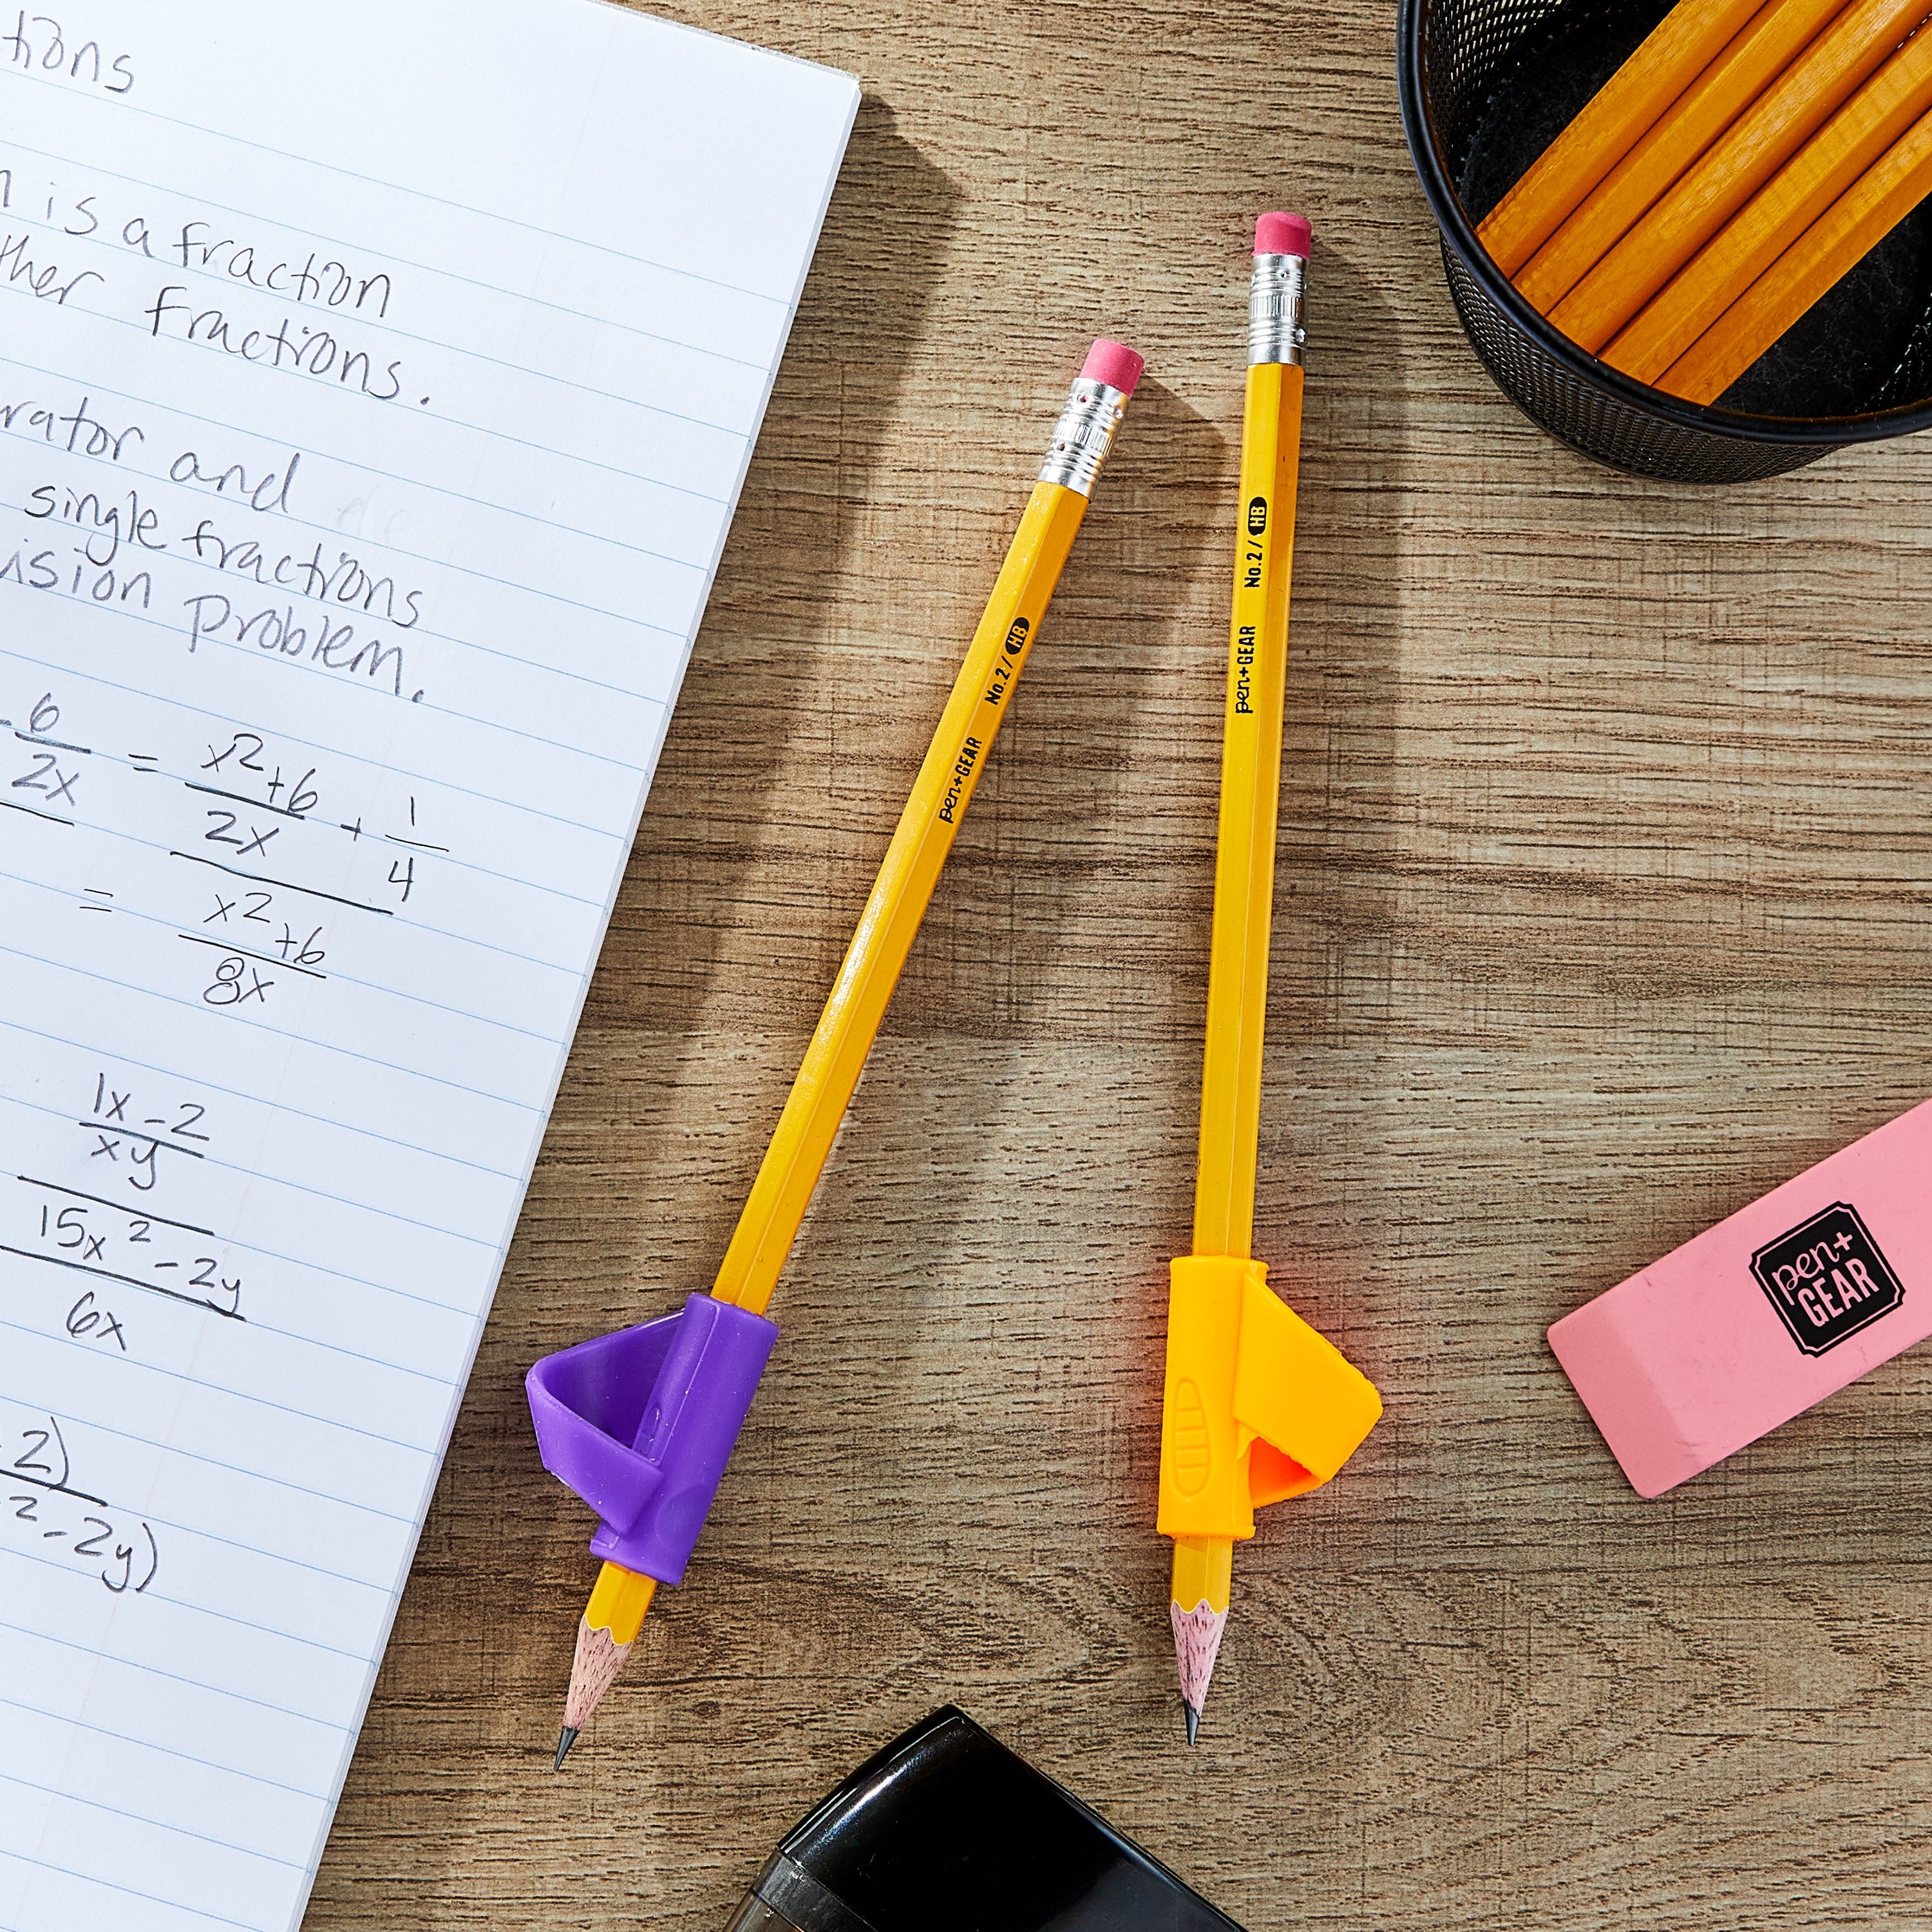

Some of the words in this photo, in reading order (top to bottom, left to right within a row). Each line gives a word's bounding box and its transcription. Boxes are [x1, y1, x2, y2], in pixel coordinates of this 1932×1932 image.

[171, 222, 390, 319] fraction
[169, 452, 300, 513] and
[1249, 502, 1266, 530] HB
[23, 483, 169, 568] single
[181, 520, 422, 629] fractions
[1244, 552, 1263, 588] No.2
[985, 667, 1010, 706] No.2
[1006, 622, 1028, 651] HB
[1797, 1257, 1880, 1327] GEAR
